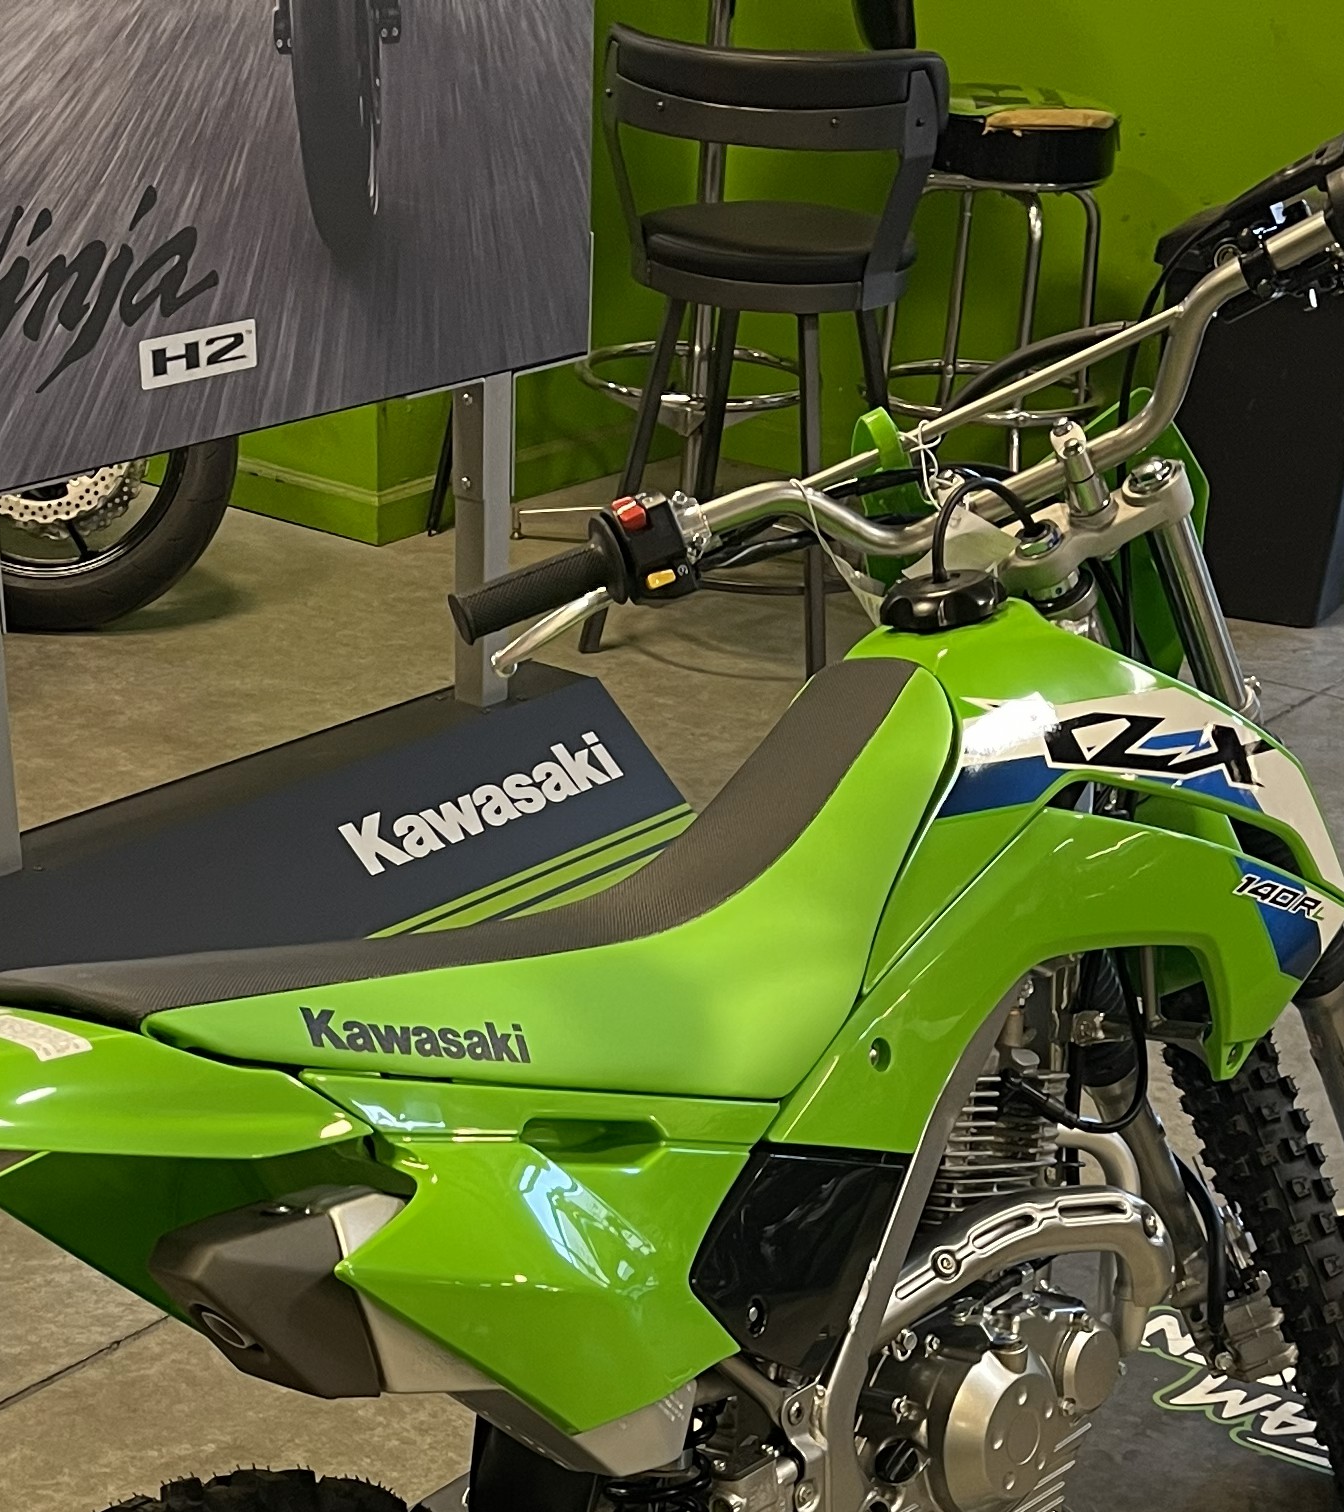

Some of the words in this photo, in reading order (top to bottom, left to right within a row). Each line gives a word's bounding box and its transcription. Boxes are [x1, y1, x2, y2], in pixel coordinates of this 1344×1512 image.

[151, 332, 248, 377] H2
[338, 731, 624, 876] Kawasaki
[299, 1007, 531, 1063] Kawasaki
